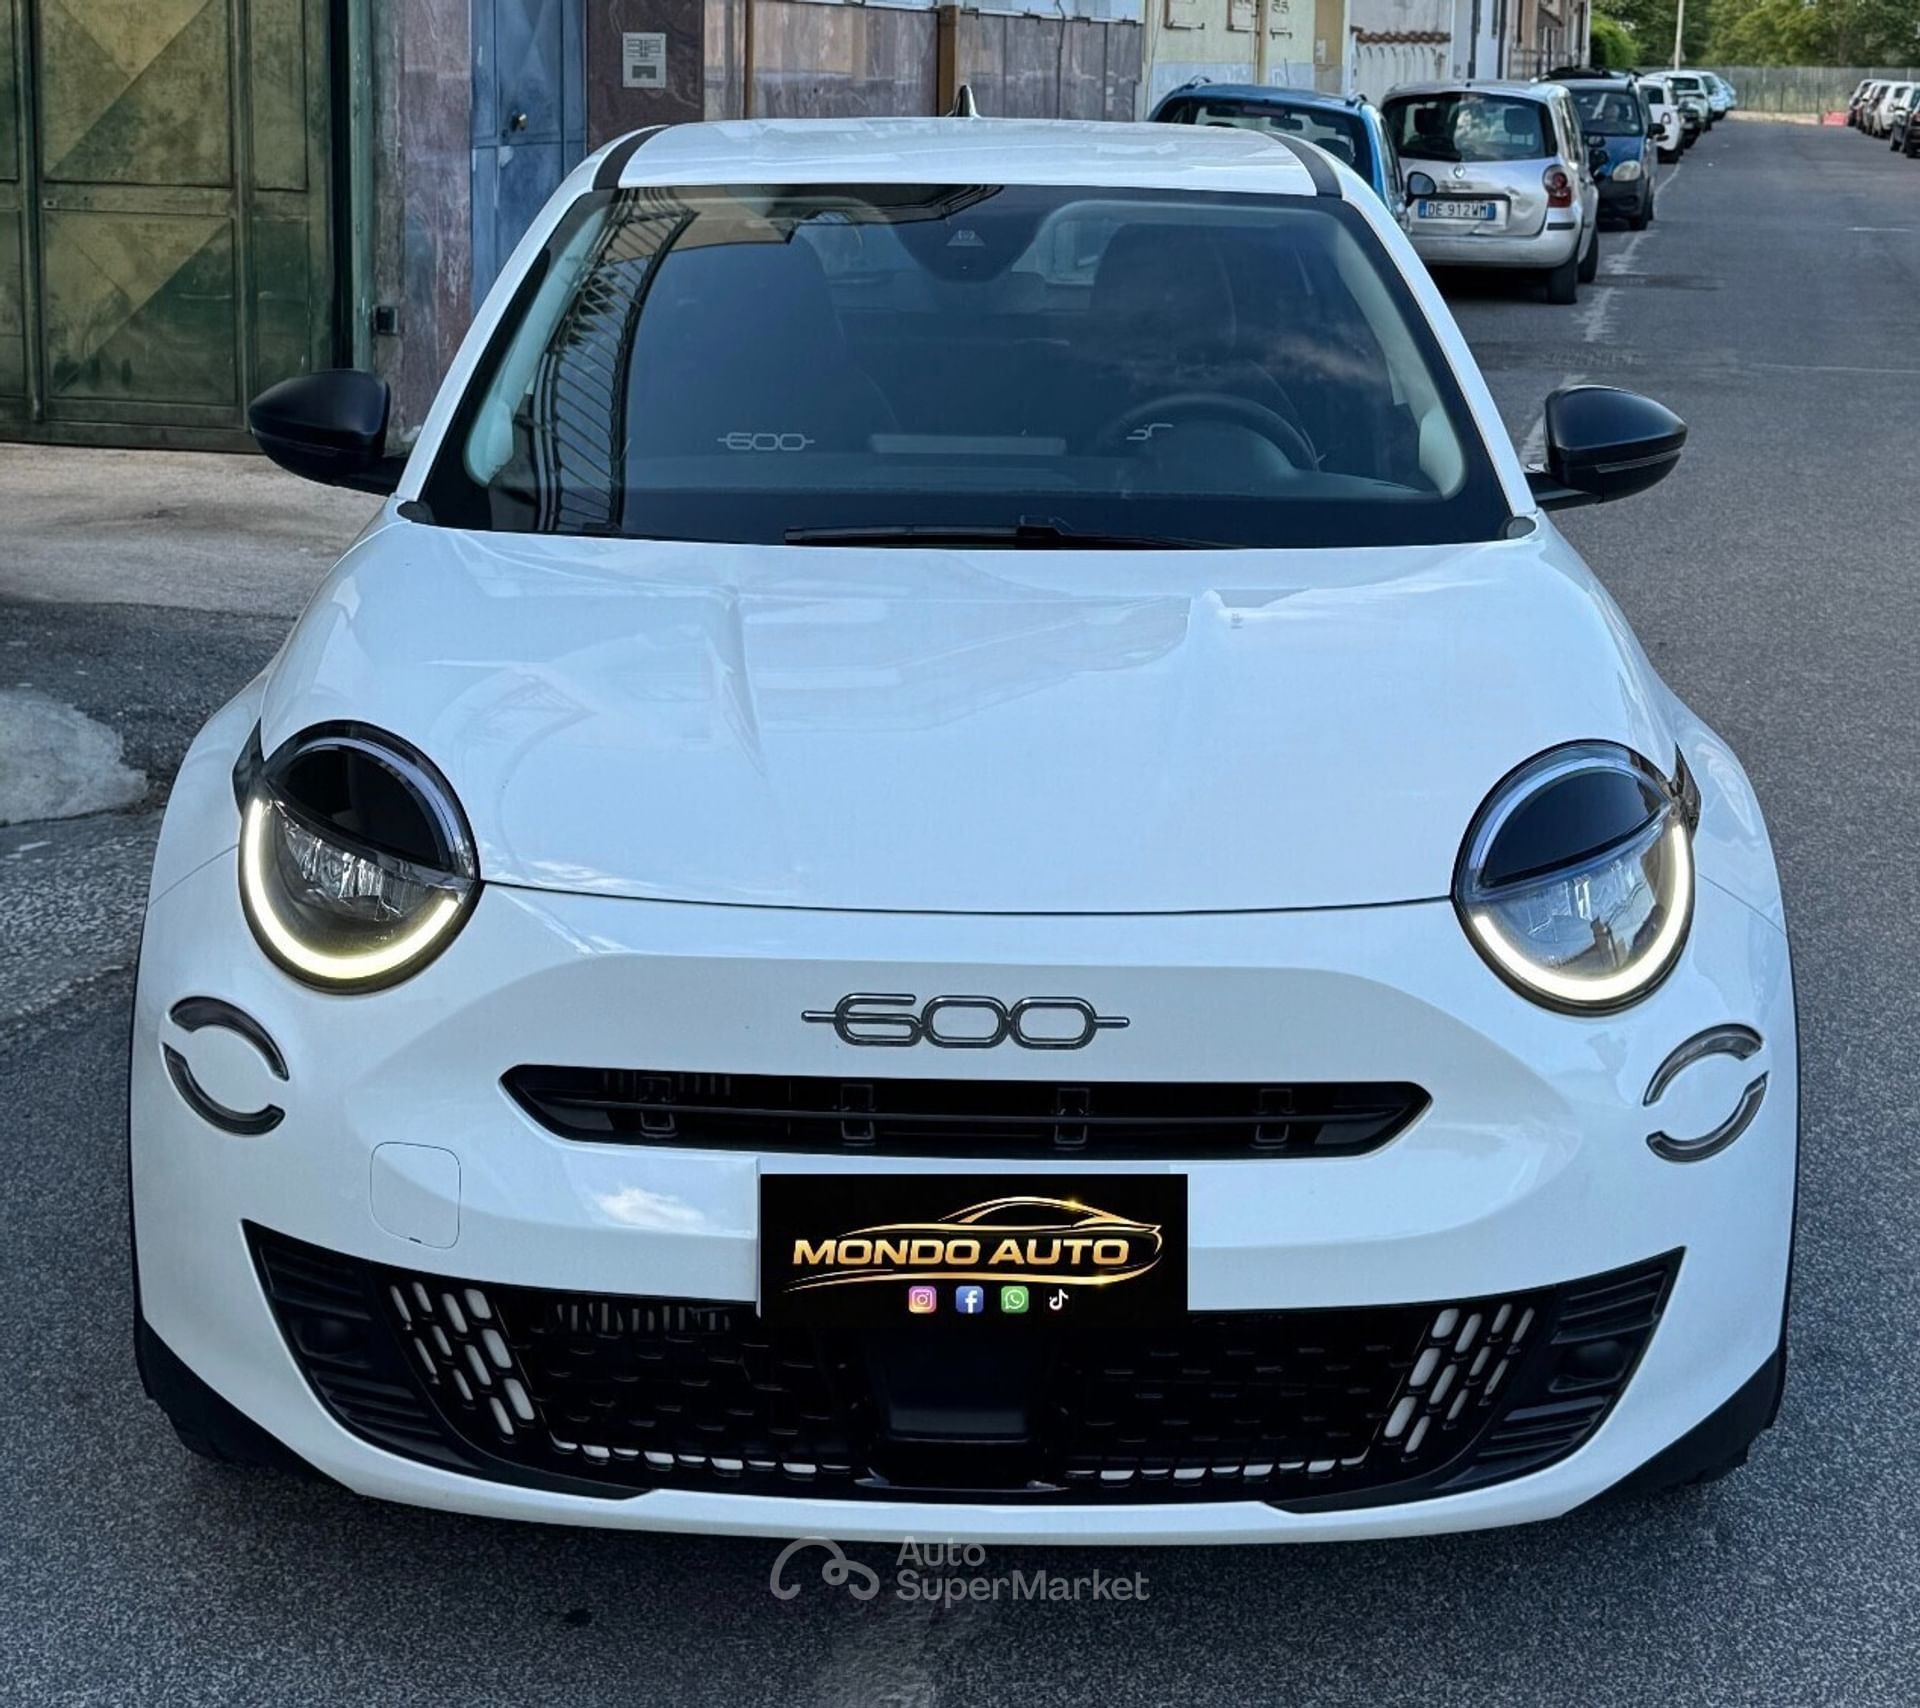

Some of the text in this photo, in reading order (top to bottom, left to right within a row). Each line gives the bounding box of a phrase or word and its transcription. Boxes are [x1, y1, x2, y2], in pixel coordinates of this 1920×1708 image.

[1427, 203, 1443, 216] DE
[717, 432, 815, 451] 600
[801, 992, 1131, 1050] 600
